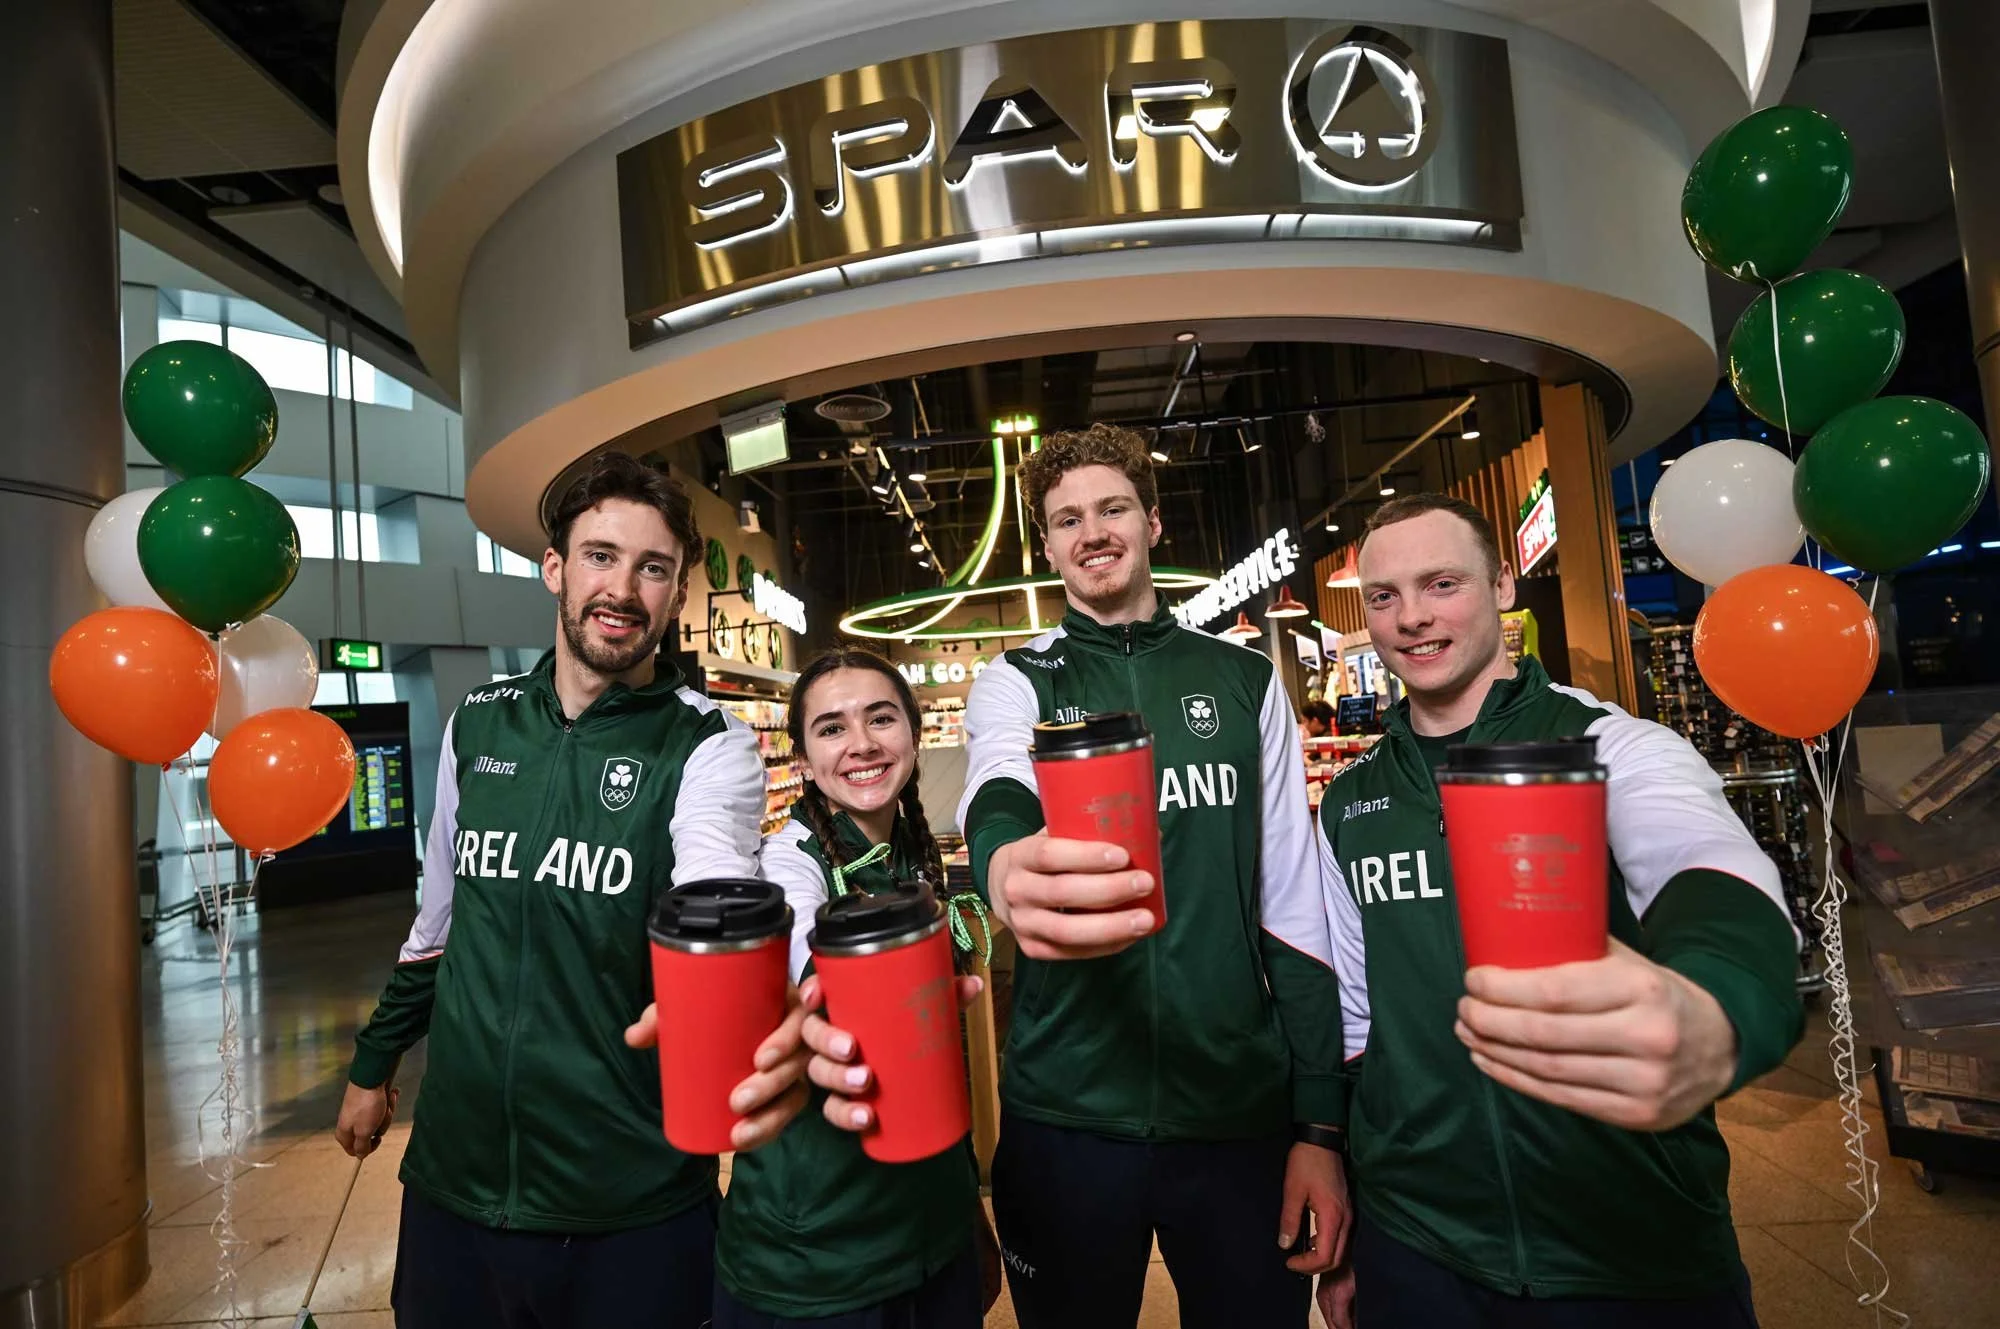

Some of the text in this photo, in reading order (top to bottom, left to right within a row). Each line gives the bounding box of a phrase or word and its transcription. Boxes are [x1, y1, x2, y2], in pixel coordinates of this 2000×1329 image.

[682, 57, 1241, 252] SPAR
[931, 662, 967, 683] GO
[1055, 706, 1092, 724] Allia
[1342, 796, 1390, 822] Allianz
